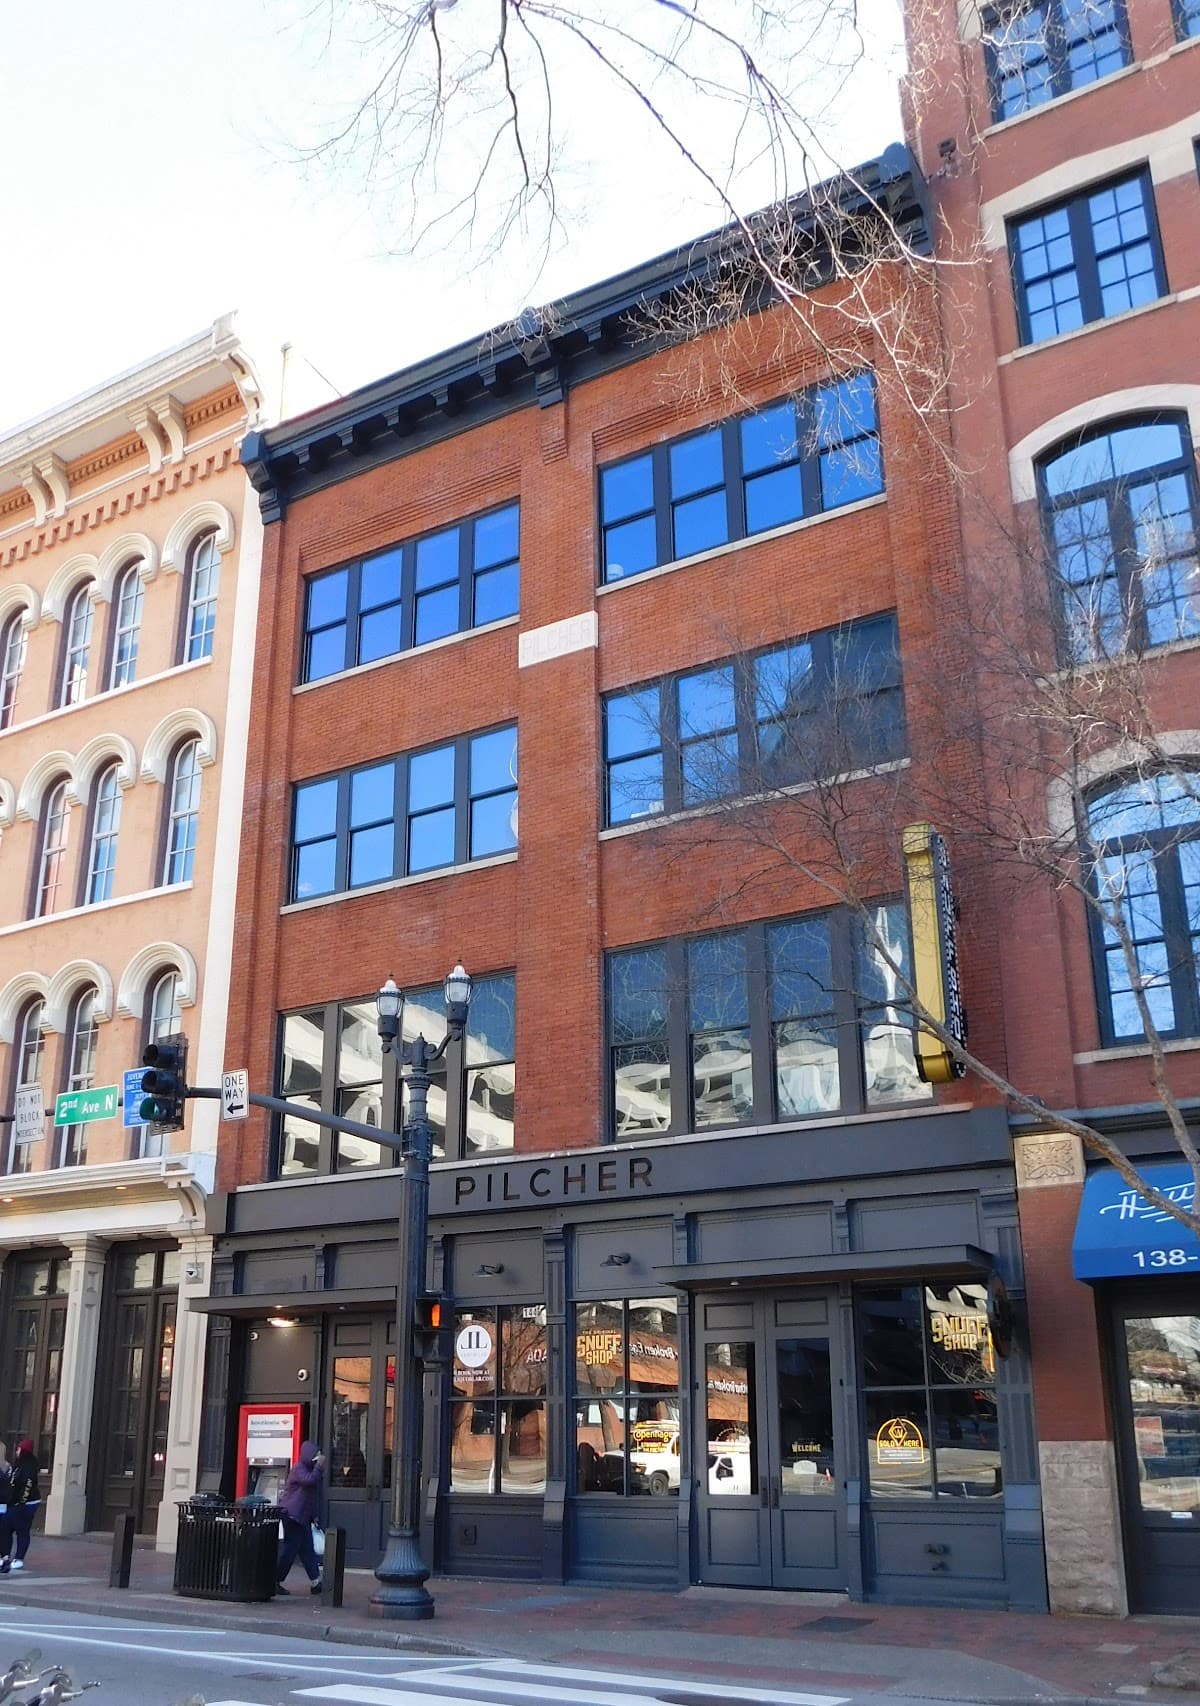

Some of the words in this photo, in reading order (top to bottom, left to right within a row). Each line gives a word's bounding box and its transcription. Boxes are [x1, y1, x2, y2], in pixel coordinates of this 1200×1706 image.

[224, 1074, 245, 1088] ONE
[30, 1094, 41, 1104] NOT
[224, 1087, 245, 1101] WAY
[59, 1097, 79, 1118] 2nd
[81, 1101, 100, 1114] Ave
[104, 1094, 114, 1111] N
[20, 1110, 40, 1124] BLOCK
[455, 1157, 654, 1206] PILCHER
[931, 1316, 987, 1343] SNUFF
[576, 1334, 622, 1358] SNUFF
[944, 1333, 978, 1351] SHOP
[586, 1350, 613, 1365] SHOP
[791, 1443, 822, 1453] WELCOME
